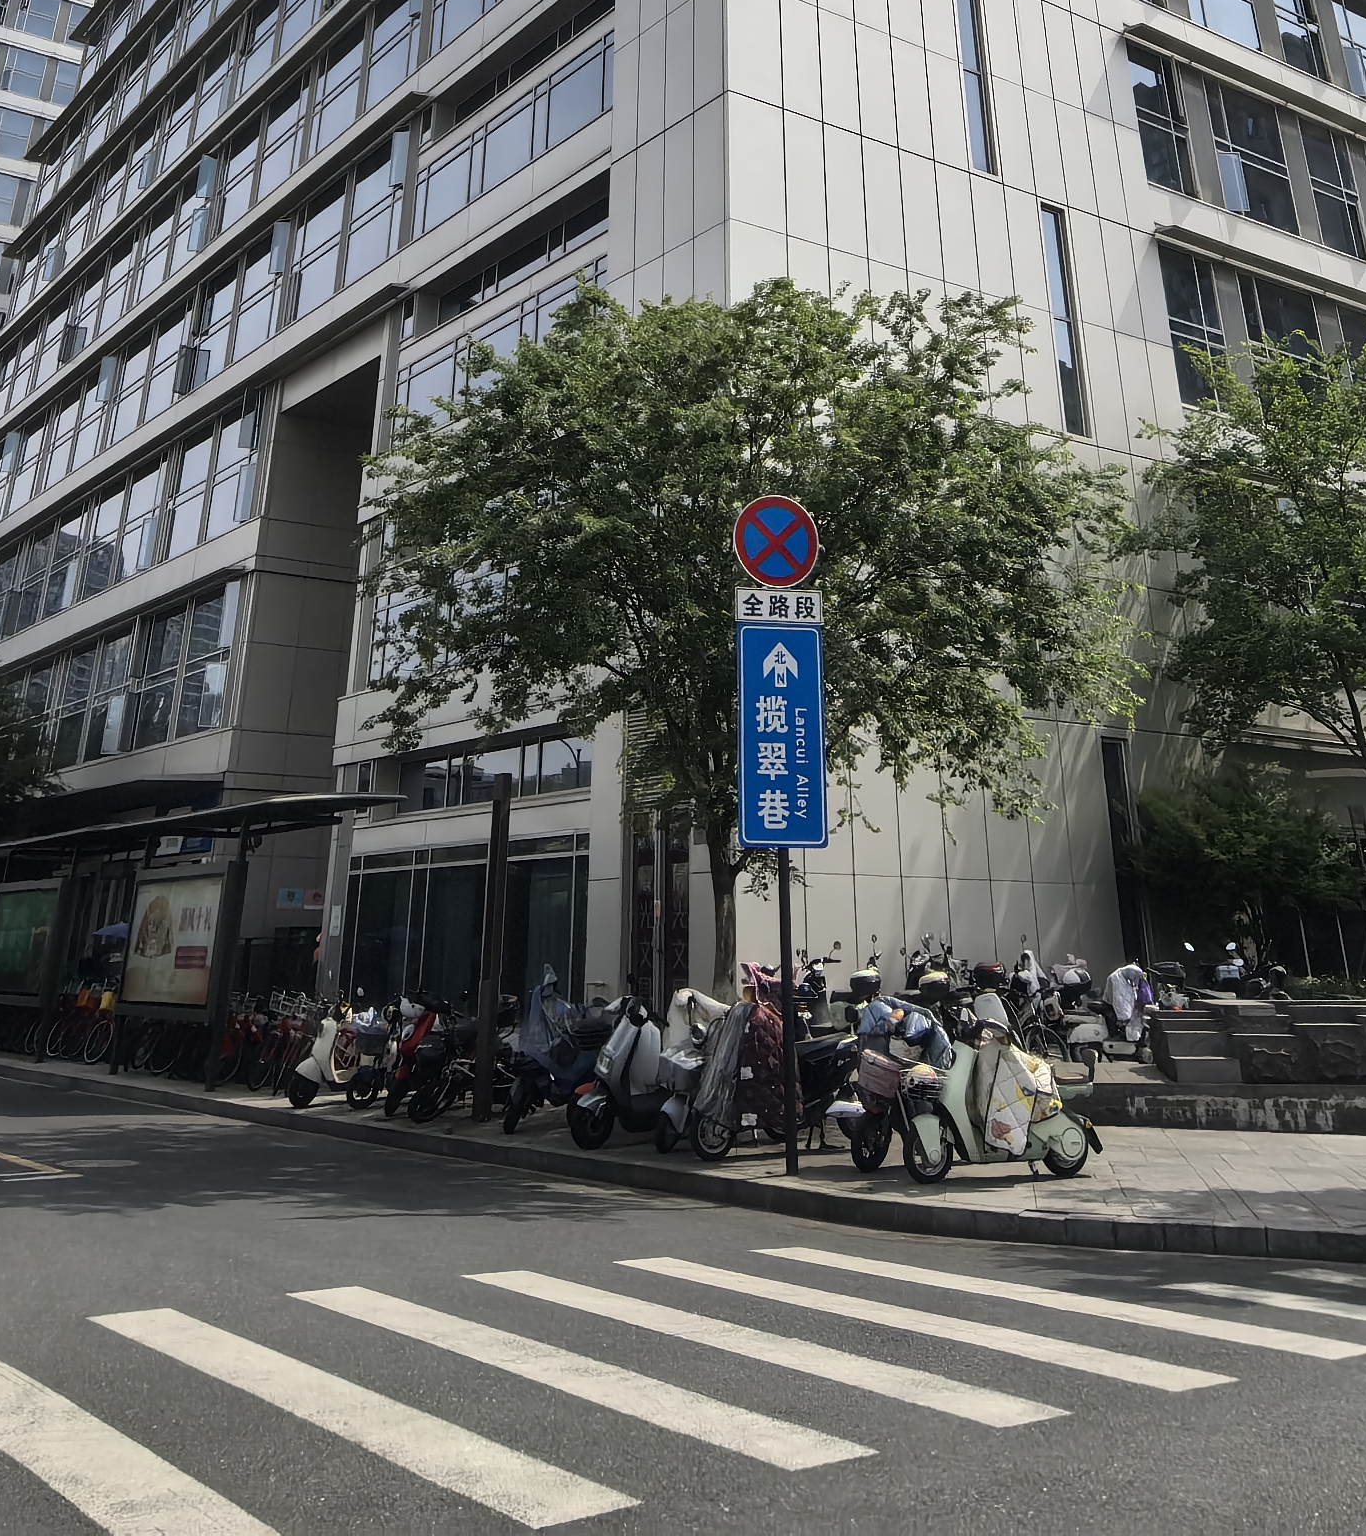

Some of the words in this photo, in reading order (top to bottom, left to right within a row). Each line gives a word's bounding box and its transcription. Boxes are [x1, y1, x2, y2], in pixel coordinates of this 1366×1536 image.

[742, 592, 816, 619] 全路段
[774, 650, 787, 665] 北
[776, 672, 786, 685] N
[794, 707, 809, 764] Lancui
[755, 695, 790, 829] 揽翠巷
[793, 774, 810, 819] Alley
